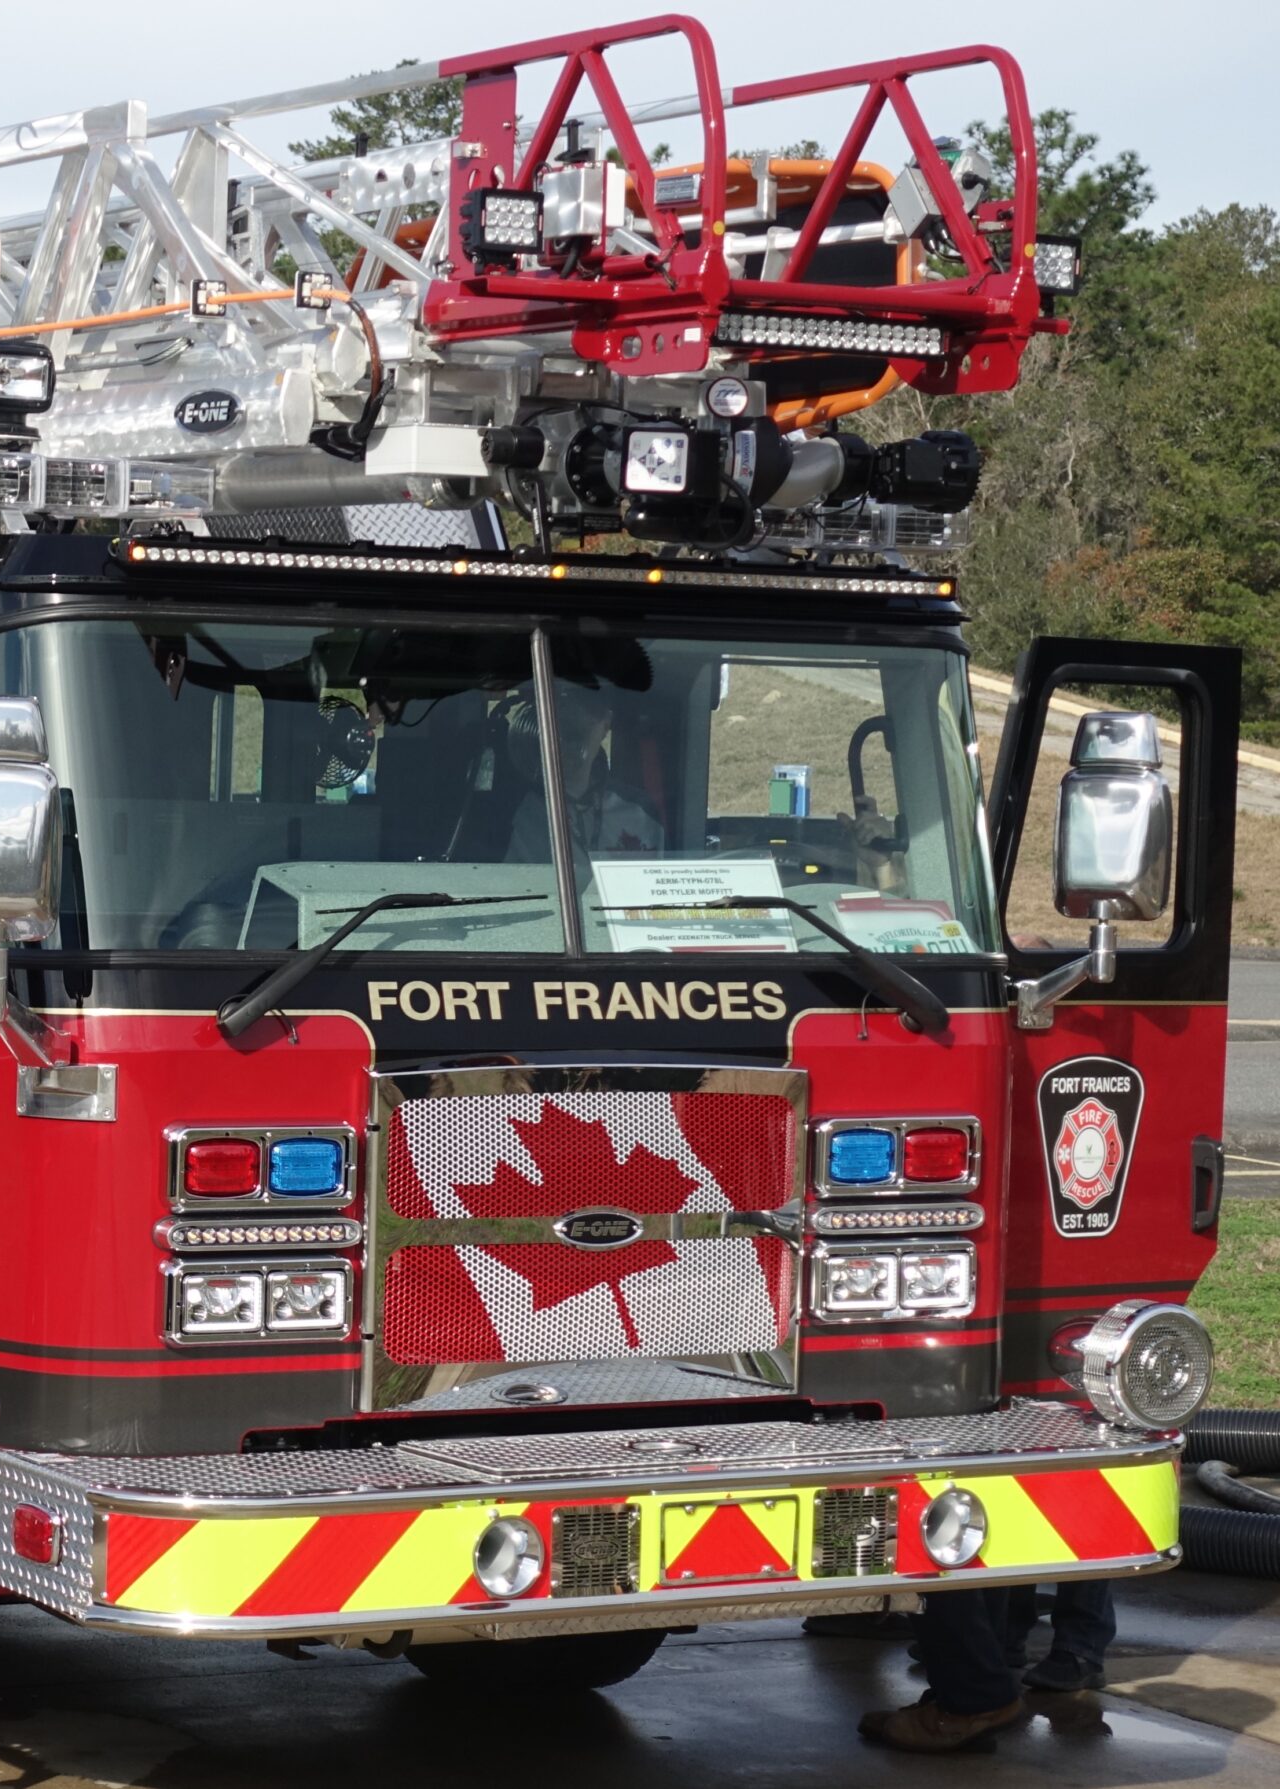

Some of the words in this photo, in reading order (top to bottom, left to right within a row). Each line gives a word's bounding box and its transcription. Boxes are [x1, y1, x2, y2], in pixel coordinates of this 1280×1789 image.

[183, 400, 230, 424] E-ONE
[651, 888, 668, 896] FOR
[670, 888, 696, 896] TYLER
[699, 888, 733, 896] MOFFITT
[647, 933, 675, 941] Dealer:
[368, 981, 510, 1020] FORT
[533, 981, 788, 1021] FRANCES
[1051, 1077, 1081, 1094] FORT
[1082, 1076, 1131, 1093] FRANCES
[1078, 1109, 1103, 1126] FIRE
[1070, 1181, 1103, 1198] RESCUE
[570, 1220, 631, 1237] E-ONE
[1062, 1213, 1085, 1230] EST.
[1086, 1212, 1109, 1228] 1903
